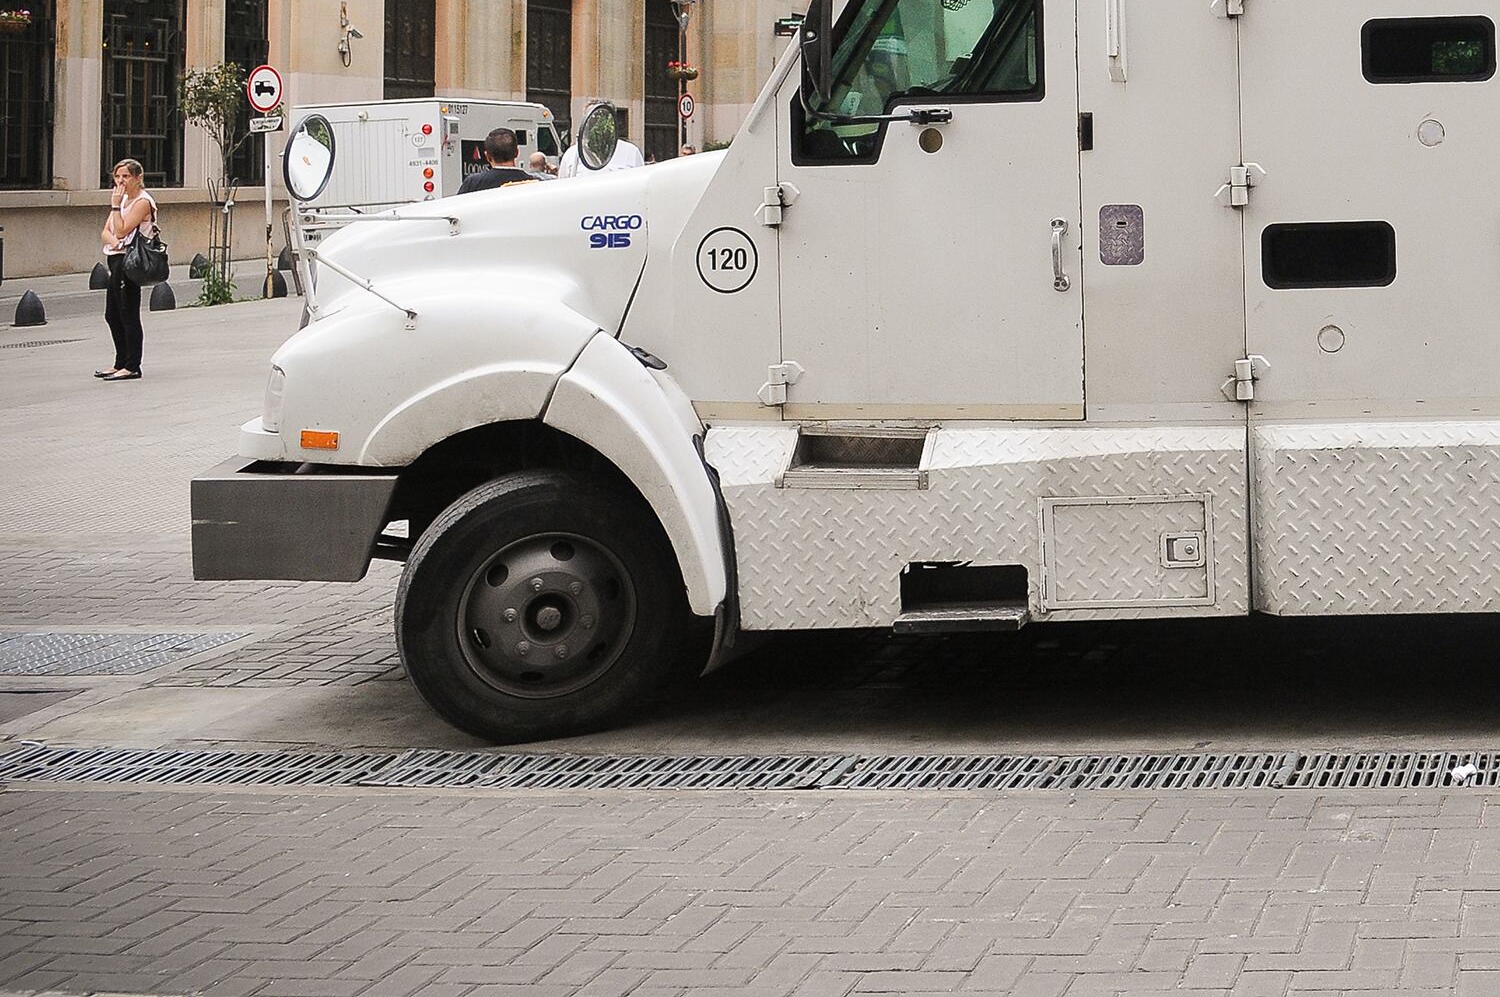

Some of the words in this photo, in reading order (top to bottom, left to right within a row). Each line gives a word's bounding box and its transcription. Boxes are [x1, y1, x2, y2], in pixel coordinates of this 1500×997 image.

[682, 101, 691, 112] 10
[581, 215, 642, 230] CARGO
[590, 233, 631, 248] 915
[707, 248, 747, 270] 120
